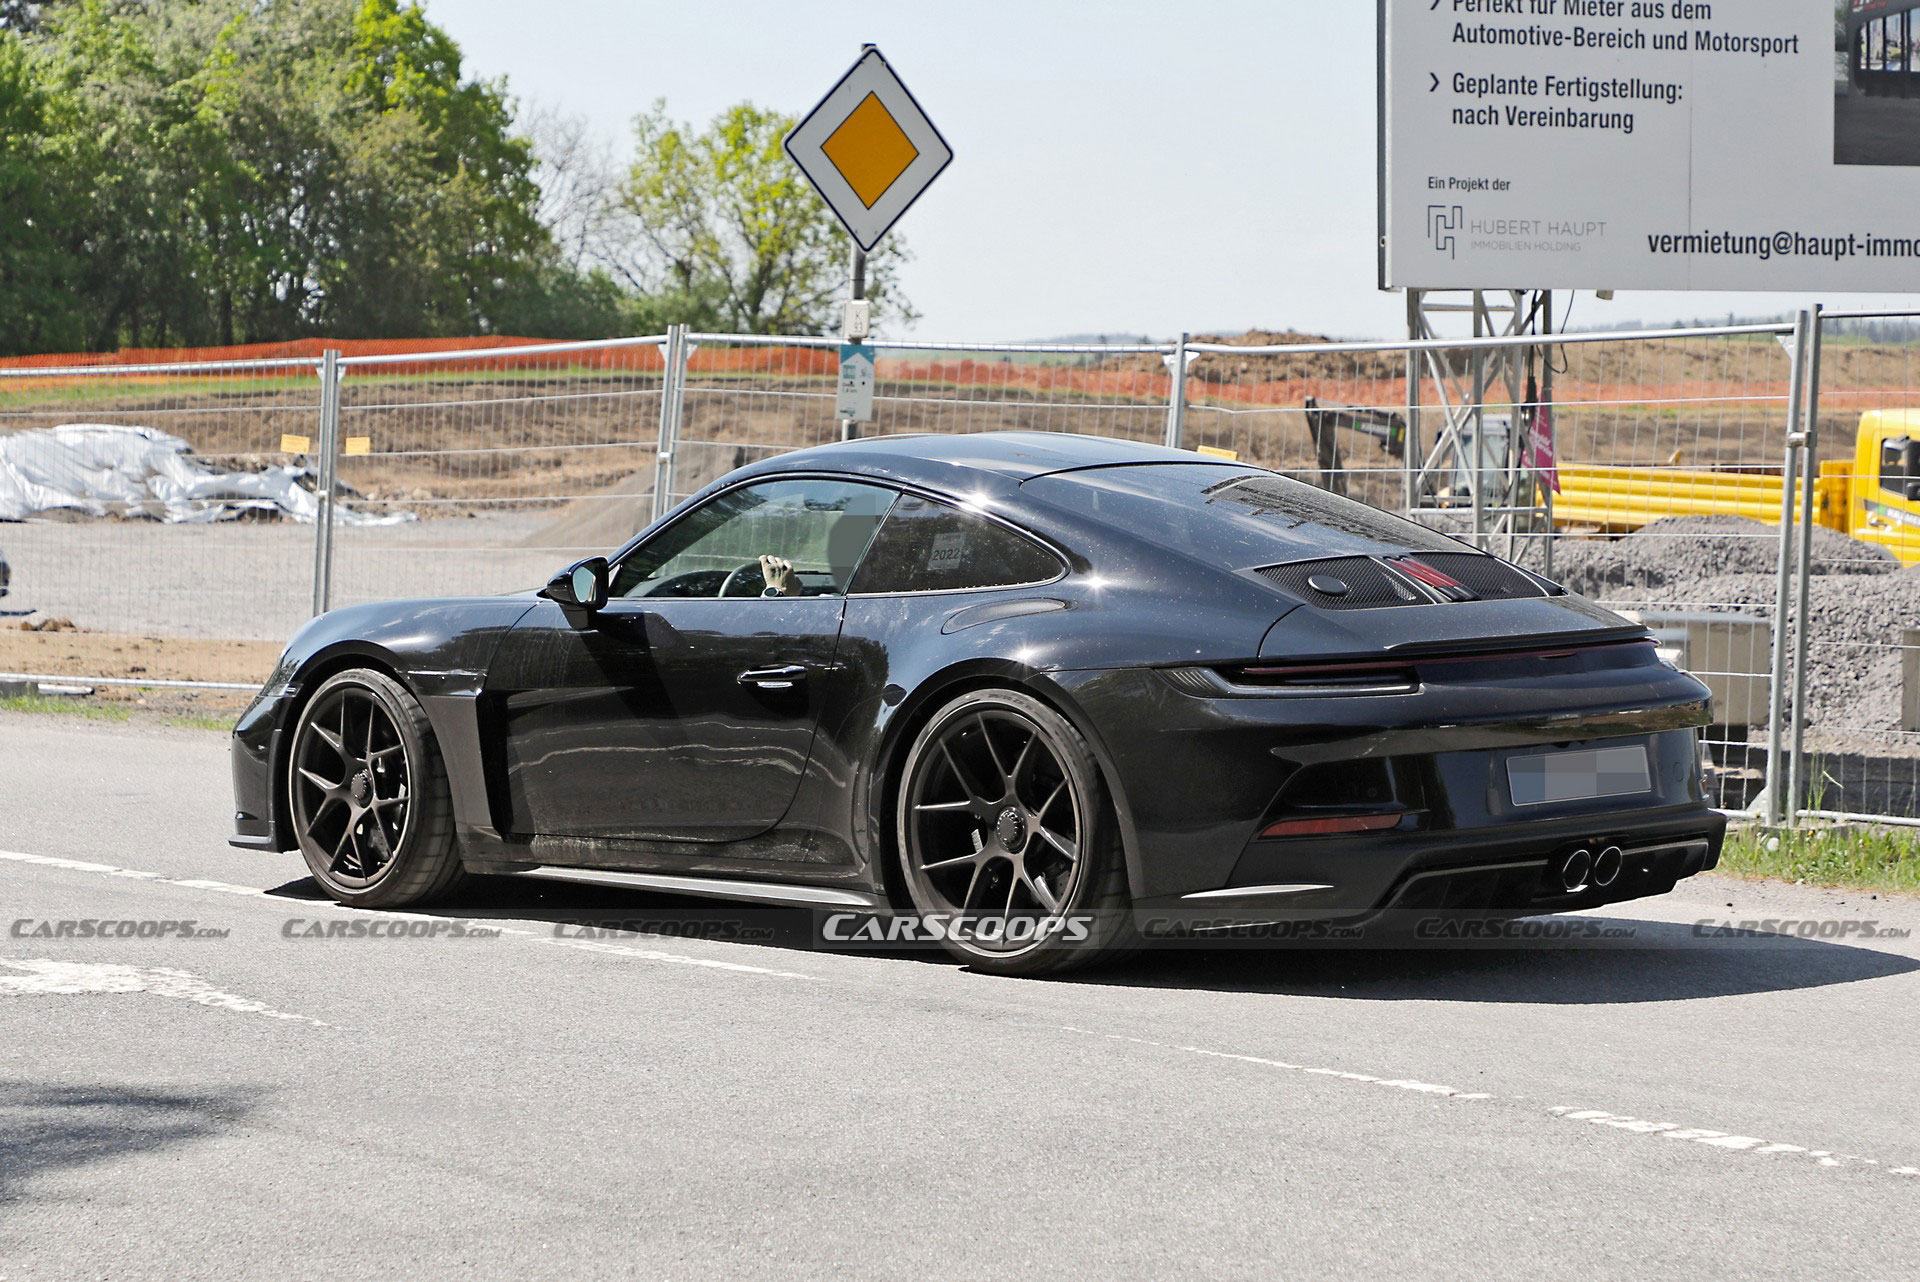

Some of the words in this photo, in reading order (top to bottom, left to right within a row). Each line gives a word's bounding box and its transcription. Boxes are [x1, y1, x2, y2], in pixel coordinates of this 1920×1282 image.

[1564, 0, 1624, 17] Mieter
[1631, 2, 1665, 19] aus
[1671, 0, 1711, 19] dem
[1453, 22, 1645, 49] Automotive-Bereich
[1653, 31, 1688, 50] und
[1695, 30, 1799, 57] Motorsport
[1452, 72, 1538, 98] Geplante
[1545, 76, 1683, 104] Fertigstellung:
[1452, 105, 1499, 125] nach
[1505, 105, 1634, 134] Vereinbarung
[1428, 176, 1445, 189] Ein
[1449, 177, 1489, 192] Projekt
[1492, 178, 1511, 190] der
[1470, 219, 1541, 235] HUBERT
[1548, 221, 1607, 237] HAUPT
[1470, 240, 1532, 251] IMMOBILIEN
[1534, 242, 1581, 252] HOLDING
[933, 549, 960, 560] 2022
